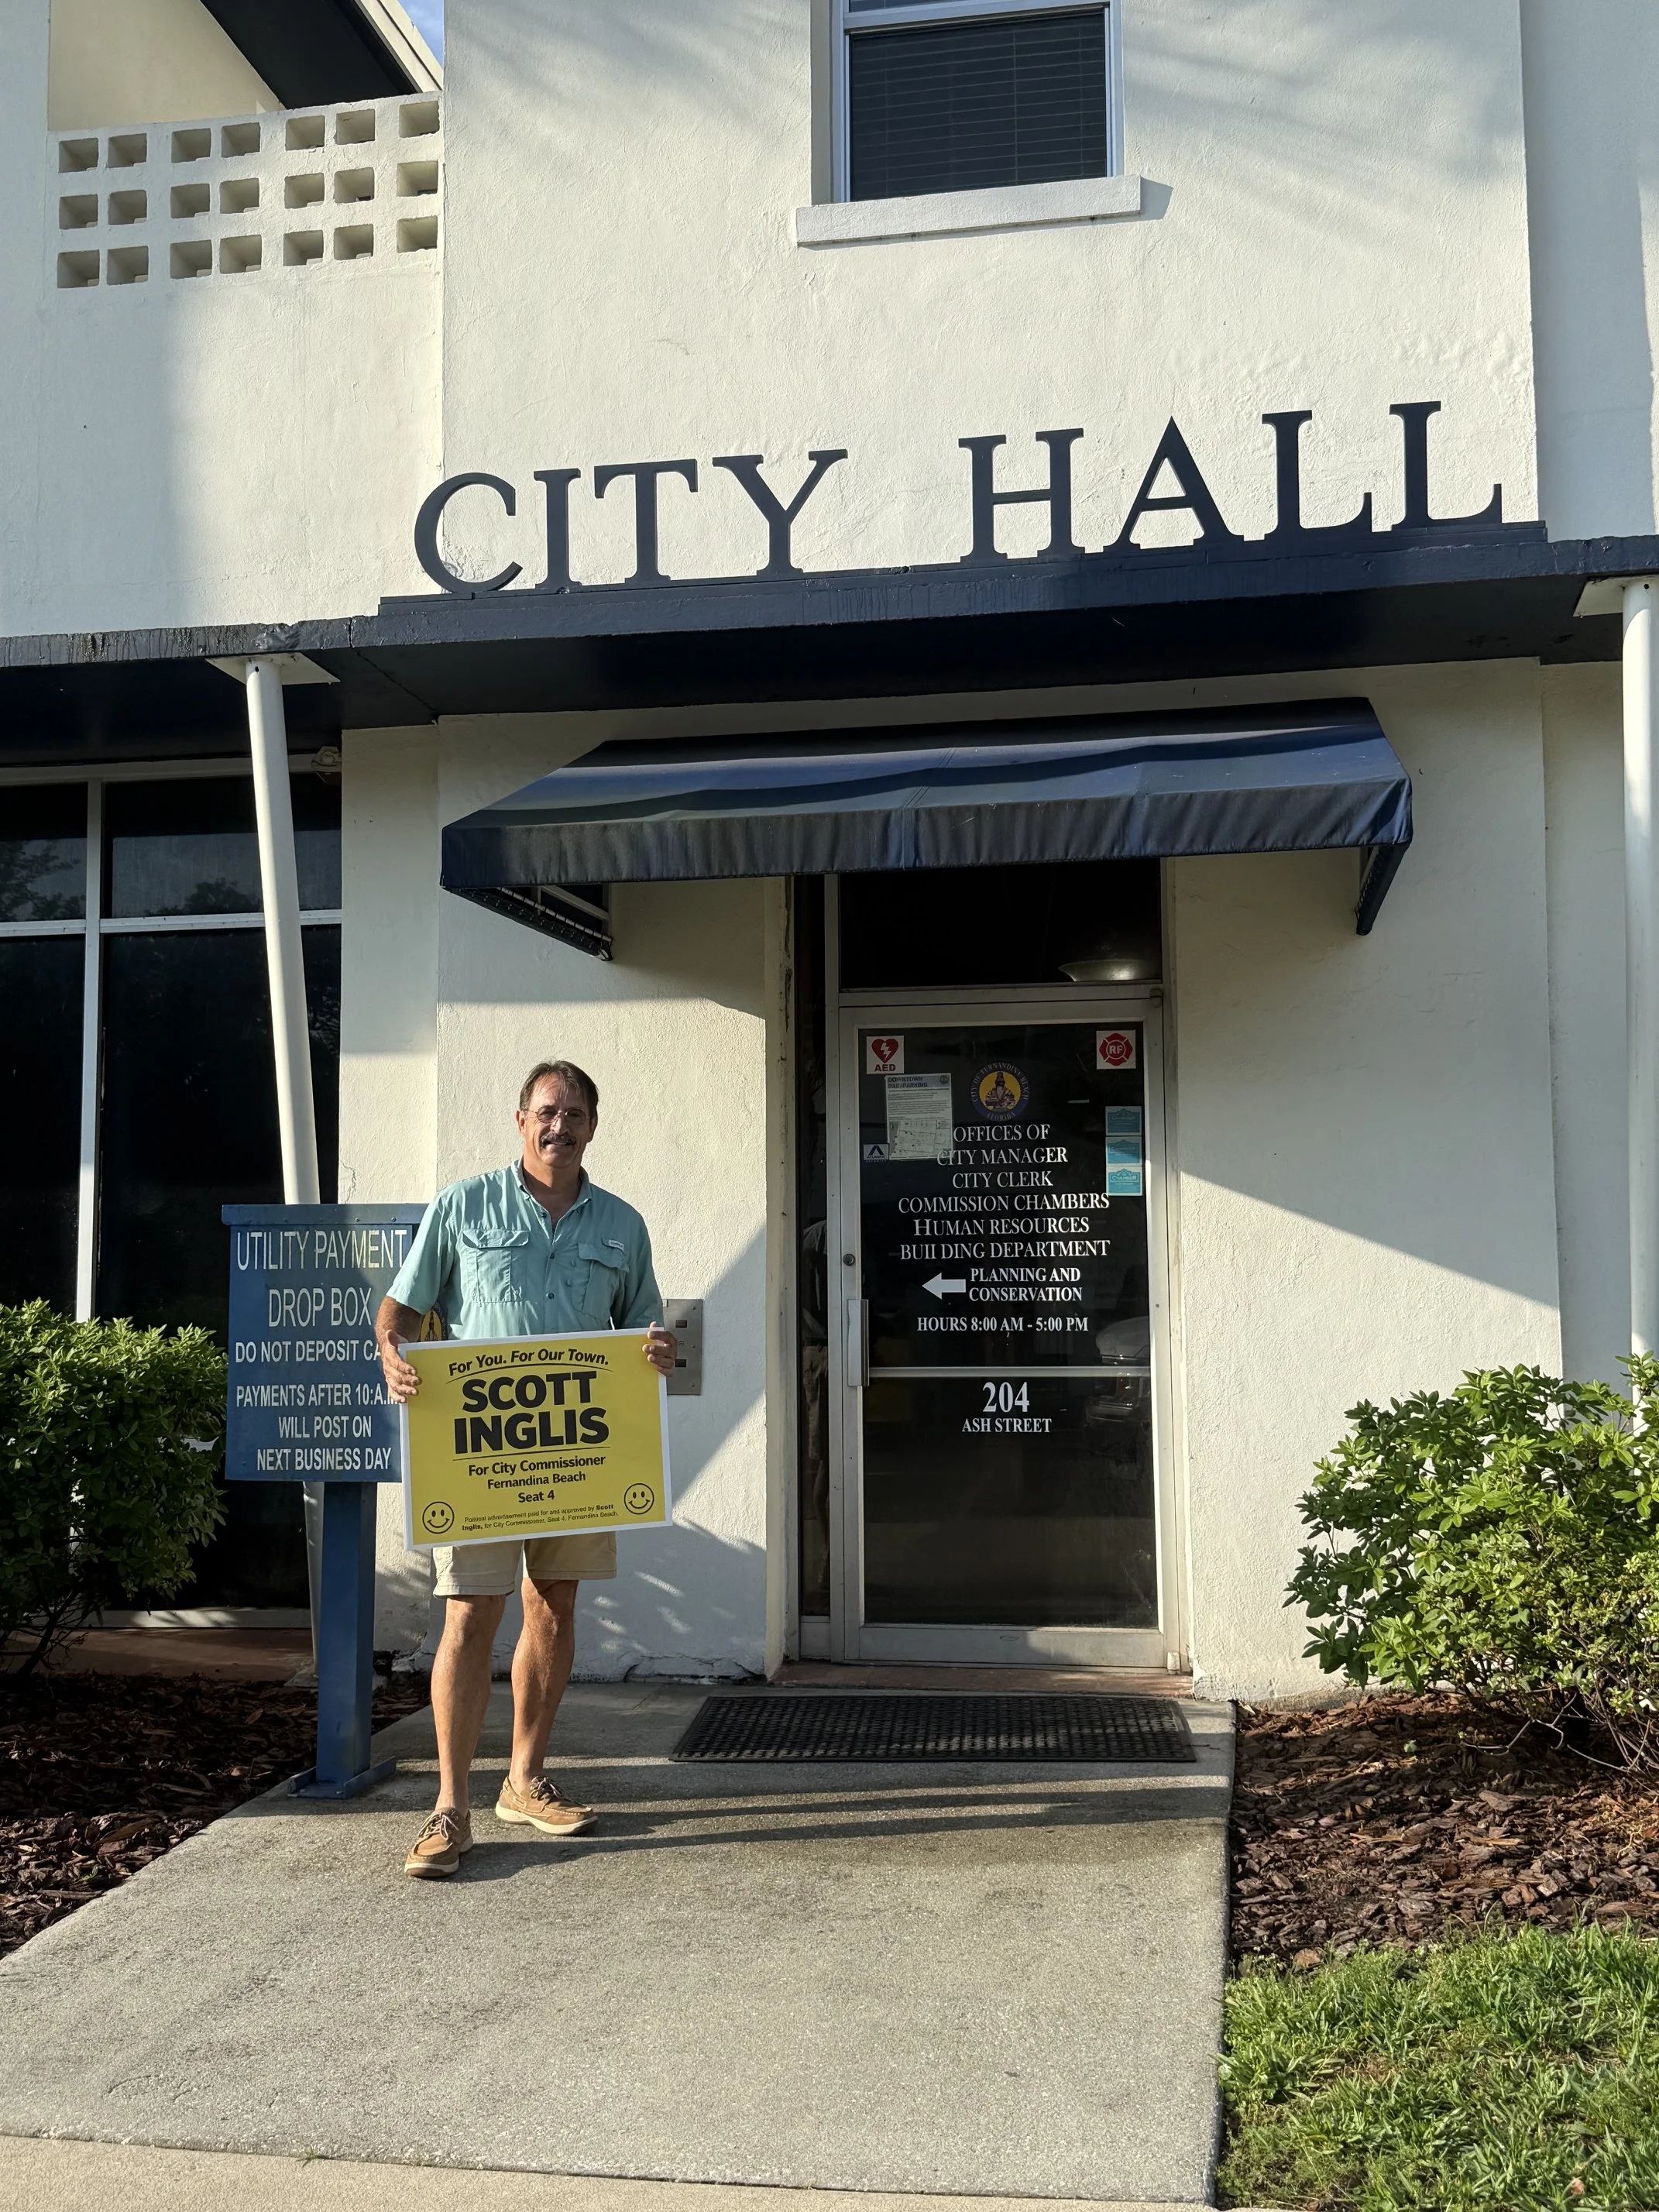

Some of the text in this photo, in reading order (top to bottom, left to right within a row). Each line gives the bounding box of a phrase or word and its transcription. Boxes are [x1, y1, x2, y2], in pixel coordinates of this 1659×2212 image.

[413, 400, 1503, 595] CITY HALL
[1109, 1045, 1123, 1055] RF
[953, 1125, 1022, 1142] OFFICES
[1026, 1124, 1050, 1141] OF
[936, 1148, 977, 1166] CITY
[981, 1146, 1068, 1165] MANAGER
[952, 1170, 1053, 1189] CITY CLERK
[898, 1193, 1110, 1213] COMMISSION CHAMBERS
[913, 1216, 1089, 1236] HUMAN RESOURCES
[237, 1229, 407, 1271] UTILITY PAYMENT
[989, 1240, 1110, 1259] DEPARTMENT
[970, 1267, 1080, 1282] PLANNING AND
[969, 1286, 1083, 1301] CONSERVATION
[269, 1287, 372, 1328] DROP BOX
[917, 1317, 967, 1331] HOURS
[971, 1317, 997, 1331] 8:00
[1000, 1317, 1024, 1331] AM
[1036, 1317, 1062, 1331] 5:00
[1066, 1317, 1088, 1331] PM
[235, 1339, 381, 1363] DO NOT DEPOSIT CA
[448, 1348, 609, 1376] For You. For Our Town.
[236, 1382, 397, 1407] PAYMENTS AFTER 10:A..
[462, 1371, 597, 1413] SCOTT
[982, 1381, 1030, 1413] 204
[279, 1416, 372, 1438] WILL POST ON
[454, 1407, 610, 1455] INGLIS
[961, 1417, 1052, 1432] ASH STREET
[257, 1447, 392, 1471] NEXT BUSINESS DAY
[469, 1455, 606, 1476] For City Commissioner
[487, 1472, 586, 1489] Fernandina Beach
[517, 1489, 555, 1503] Seat 4
[487, 1512, 527, 1521] advertisement
[568, 1513, 599, 1521] Fernandina
